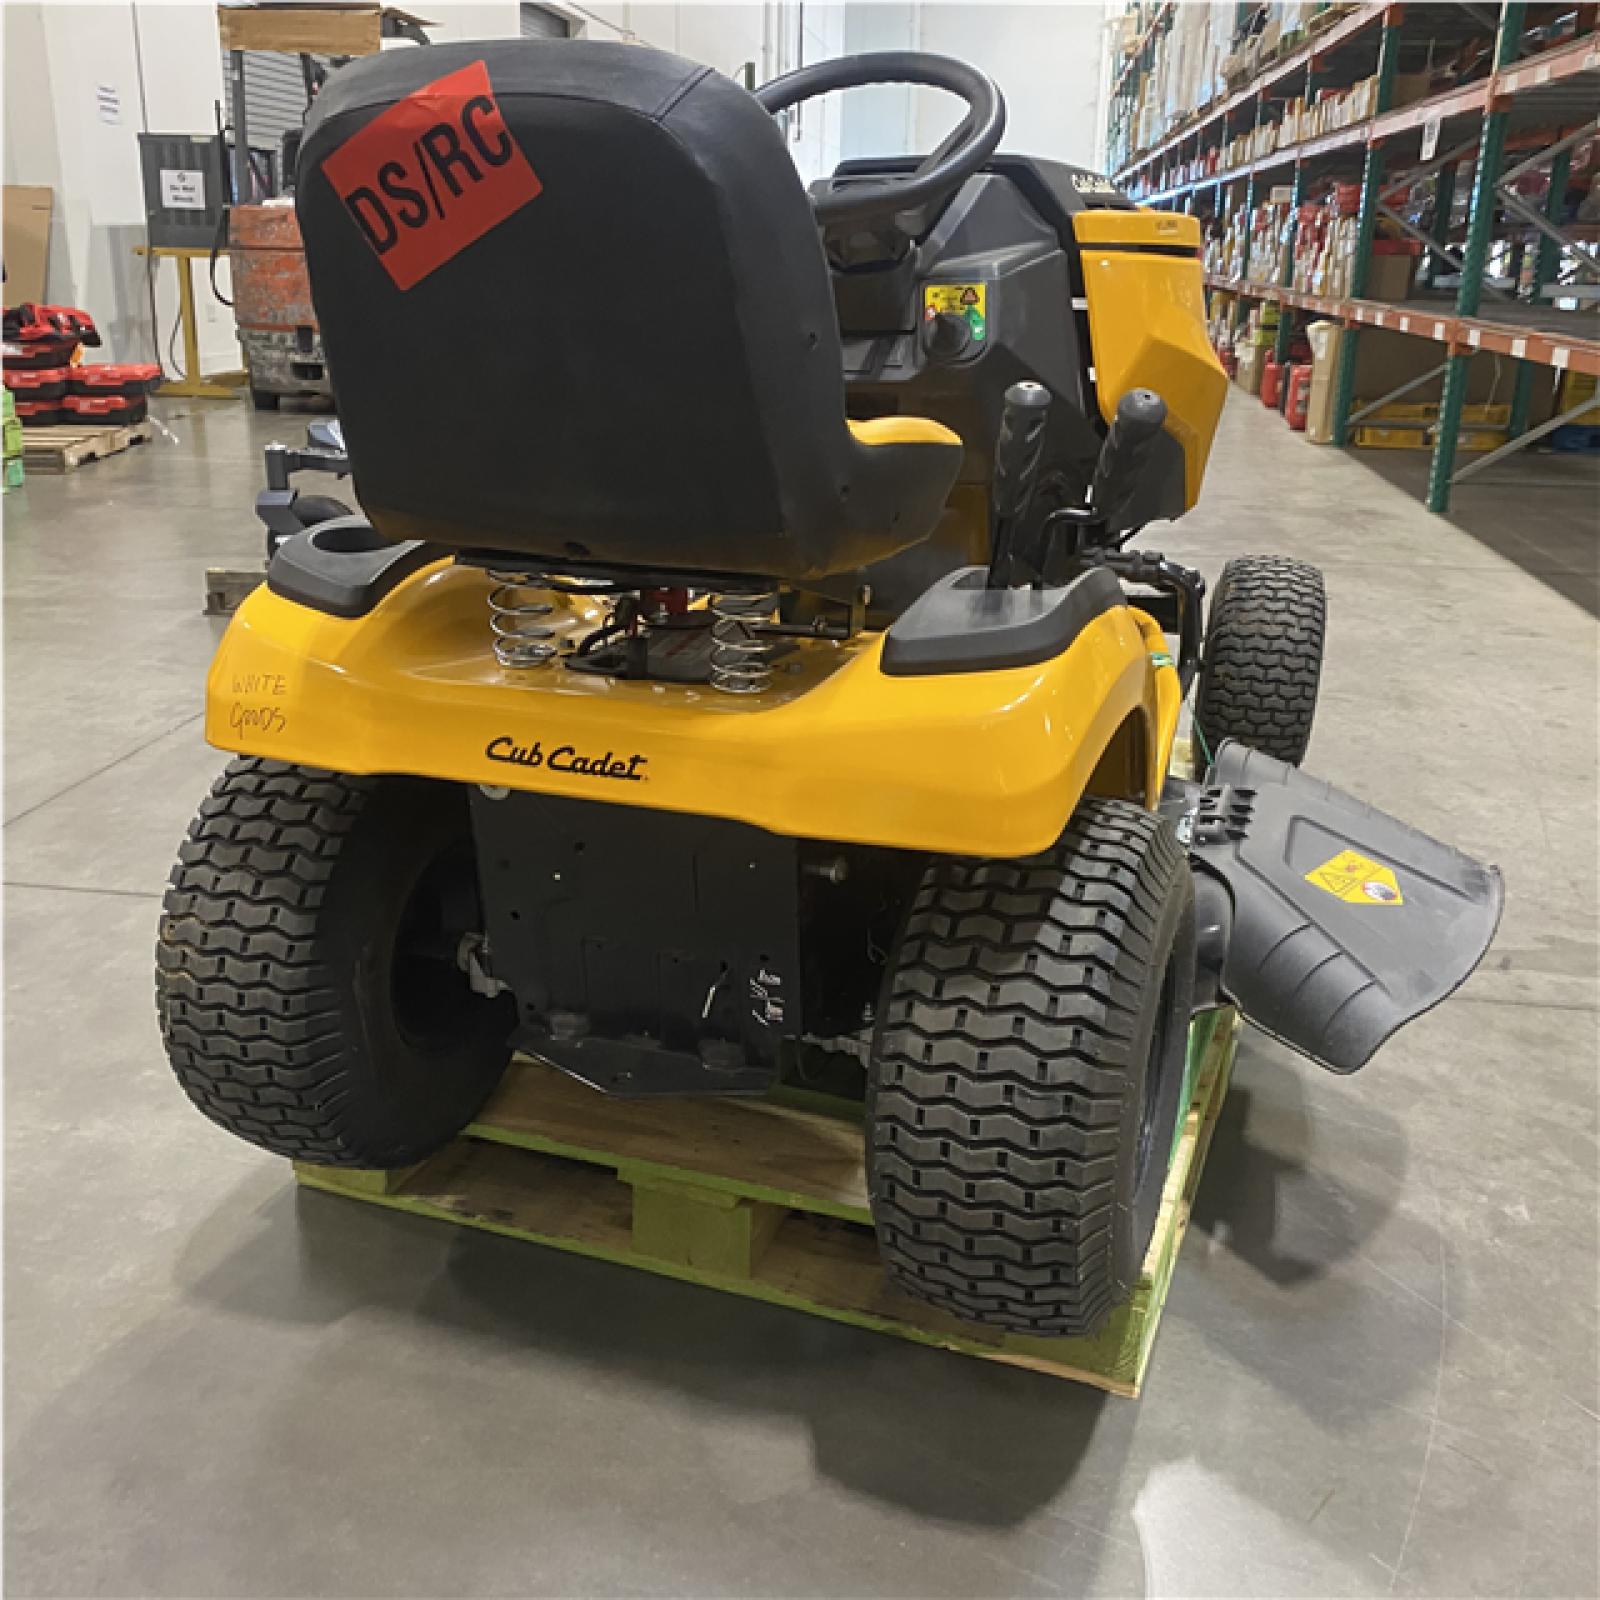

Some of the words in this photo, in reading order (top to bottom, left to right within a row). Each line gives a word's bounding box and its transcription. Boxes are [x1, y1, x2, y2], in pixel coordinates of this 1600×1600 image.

[345, 95, 513, 256] DS/RC
[485, 736, 542, 766] Cub
[547, 744, 648, 781] Cadet
